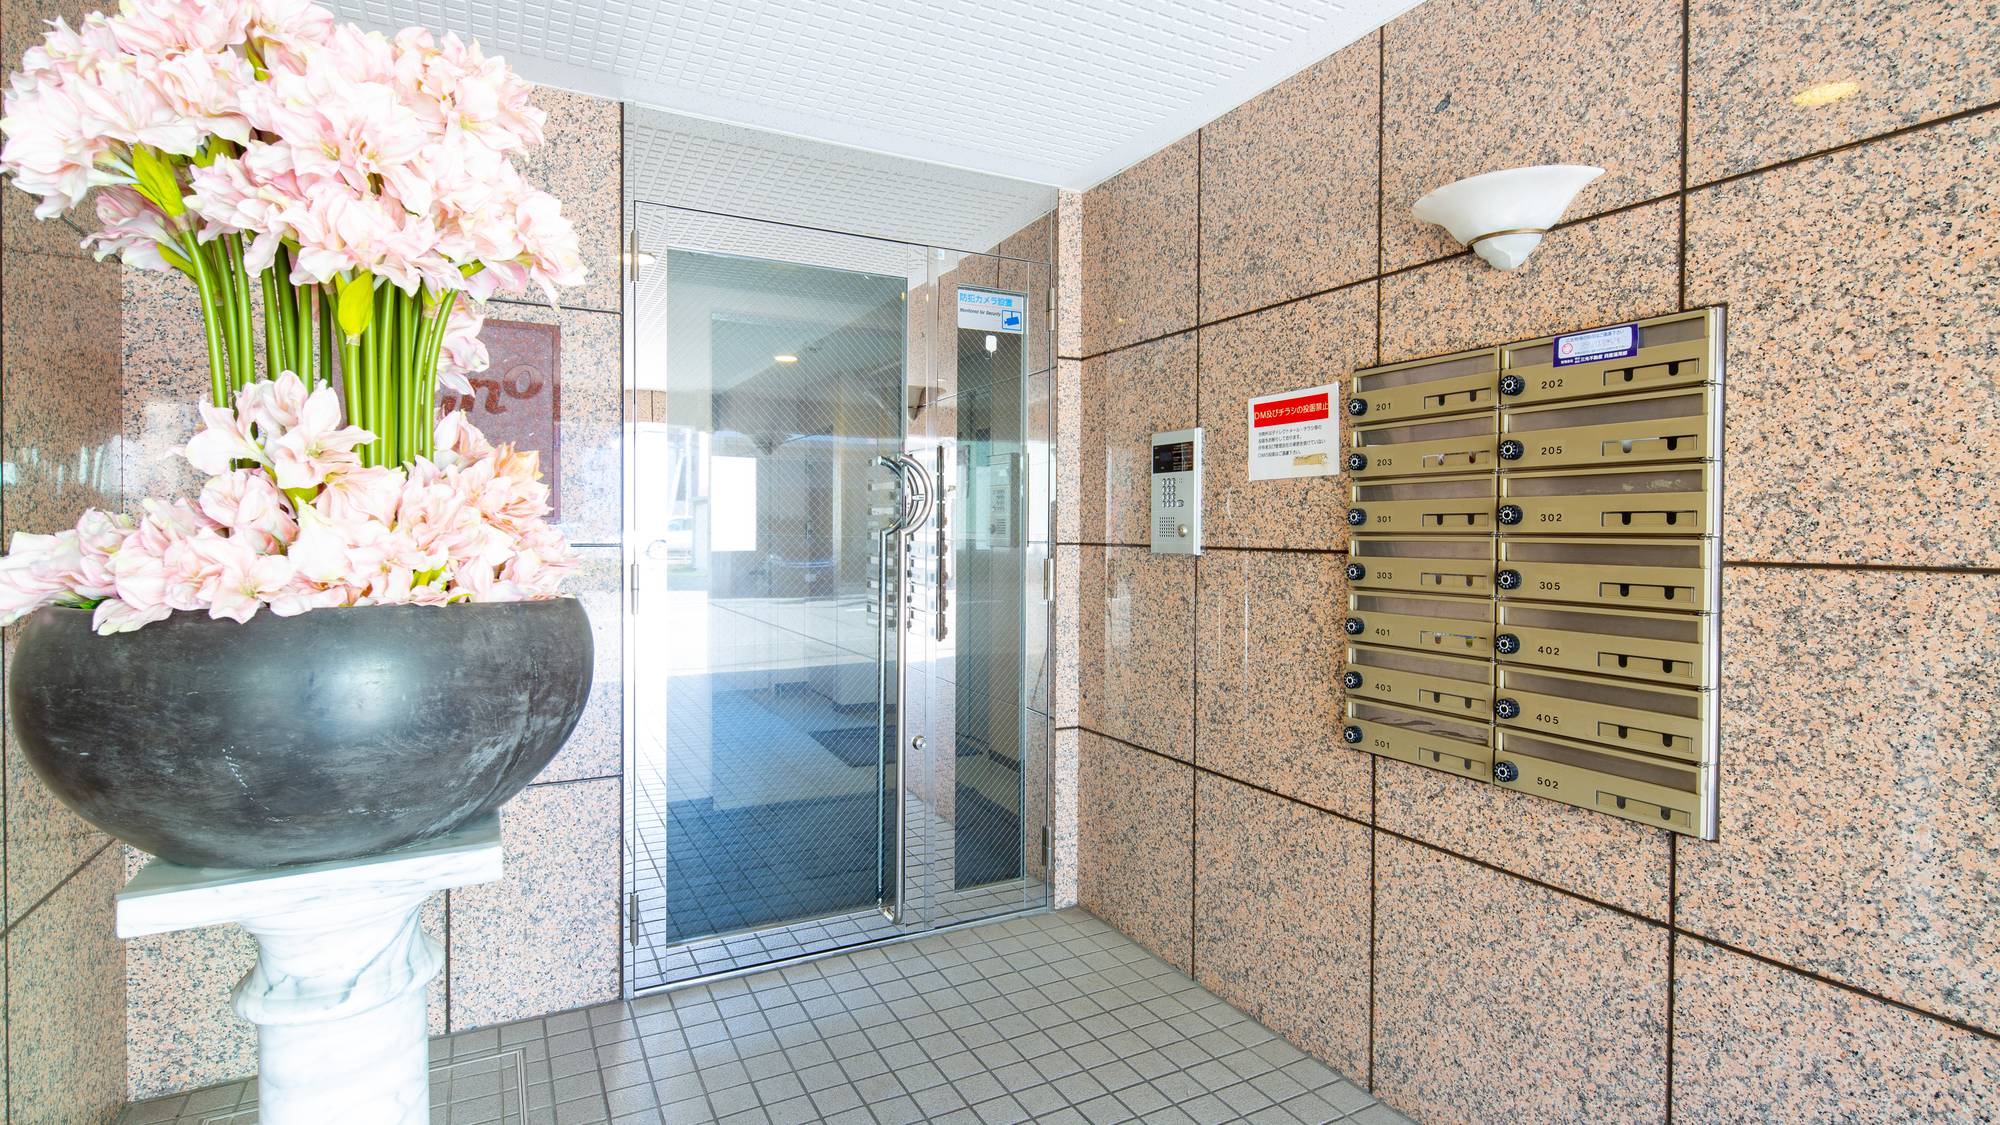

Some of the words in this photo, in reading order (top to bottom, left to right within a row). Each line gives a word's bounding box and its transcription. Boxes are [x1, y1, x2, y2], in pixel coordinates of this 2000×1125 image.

[960, 293, 1013, 307] 防犯カメラ設置
[1541, 379, 1563, 389] 202
[1254, 402, 1328, 420] DM及びチラシの投函禁止
[1376, 402, 1391, 411] 201
[1541, 446, 1562, 456] 205
[1377, 459, 1392, 467] 203
[1377, 516, 1391, 524] 301
[1540, 513, 1563, 523] 302
[1377, 571, 1392, 580] 303
[1539, 581, 1560, 591] 305
[1375, 627, 1390, 637] 401
[1538, 645, 1560, 656] 402
[1375, 683, 1392, 693] 403
[1536, 713, 1559, 725] 405
[1375, 738, 1390, 750] 501
[1537, 776, 1559, 790] 502
